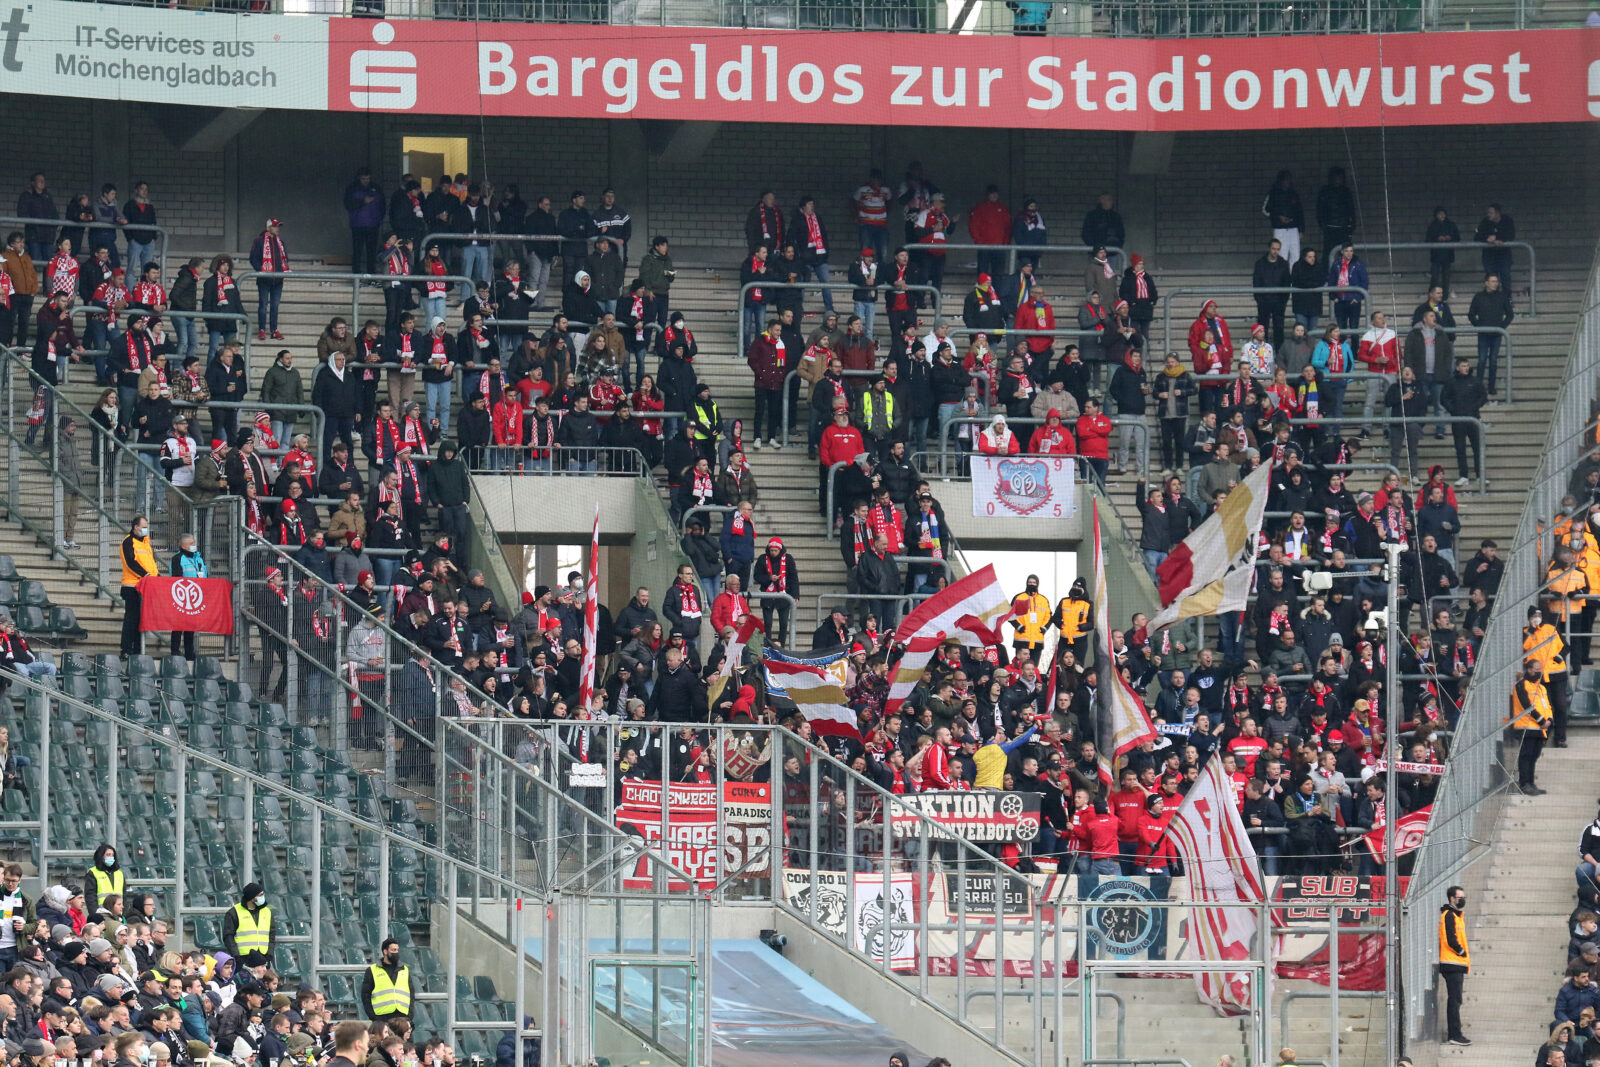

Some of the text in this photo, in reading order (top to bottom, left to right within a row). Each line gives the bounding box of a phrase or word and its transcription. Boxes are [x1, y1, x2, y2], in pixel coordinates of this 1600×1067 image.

[75, 25, 255, 58] IT-Services aus
[55, 53, 278, 88] Mönchengladbach
[478, 41, 1532, 113] Bargeldlos zur Stadionwurst
[985, 458, 991, 470] 1
[1054, 458, 1062, 472] 9
[986, 502, 1062, 517] 0 5
[891, 794, 996, 819] SEKTION
[647, 849, 717, 878] OYS
[786, 873, 835, 885] CONRO
[1301, 876, 1358, 896] SUB
[953, 891, 1023, 904] PARASO
